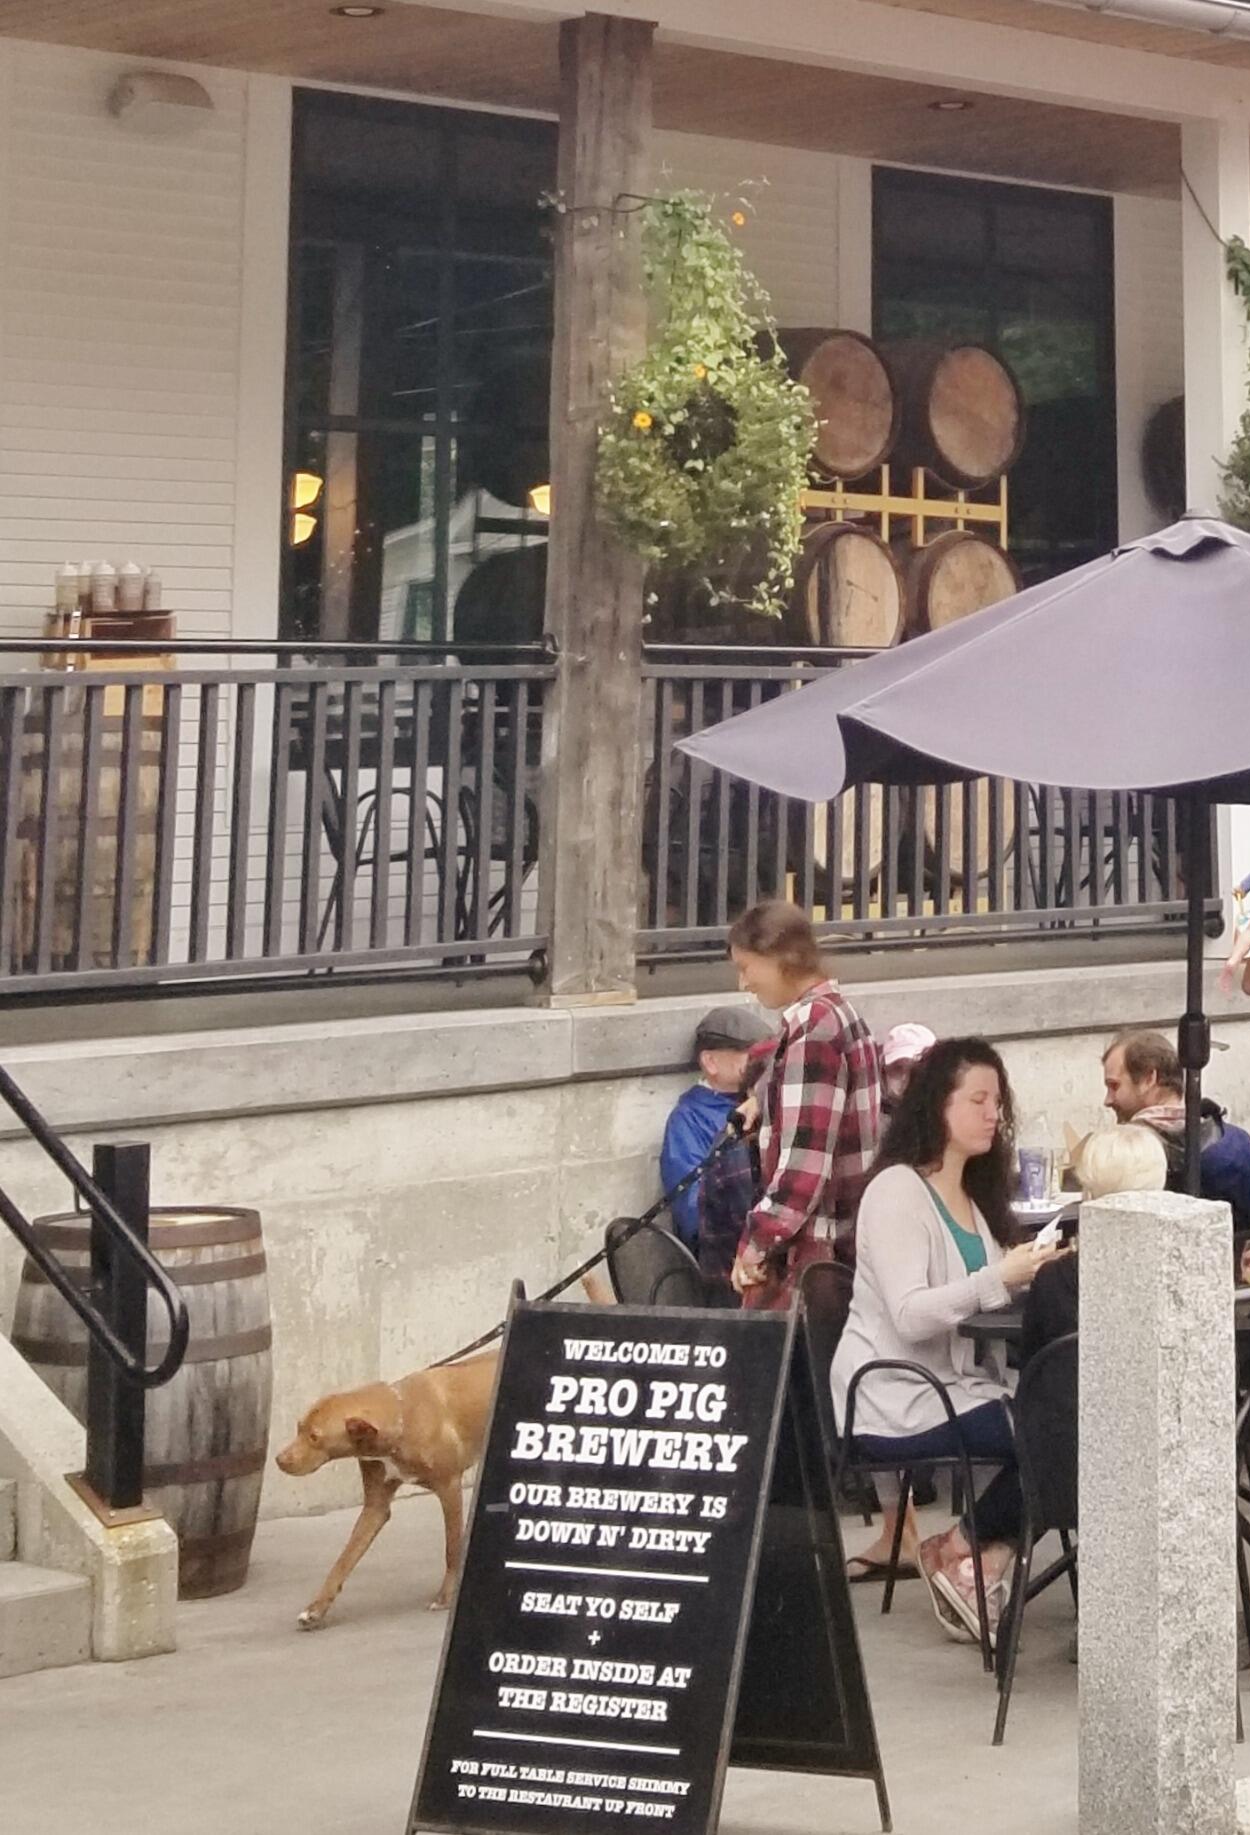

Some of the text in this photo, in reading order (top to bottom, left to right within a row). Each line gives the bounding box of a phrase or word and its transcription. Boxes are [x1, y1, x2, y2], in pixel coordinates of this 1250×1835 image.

[564, 1339, 727, 1368] WELCOME TO
[545, 1376, 727, 1422] PRO PIG
[511, 1422, 748, 1472] BREWERY
[510, 1483, 727, 1519] OUR BREWERY IS
[515, 1519, 712, 1553] DOWN N' DIRTY
[521, 1592, 680, 1623] SEAT YO SELF
[588, 1630, 601, 1645] +
[489, 1652, 692, 1688] ORDER INSIDE AT
[498, 1687, 667, 1721] THE REGISTER
[451, 1760, 690, 1795] FOR FULL TABLE SERVICE SHIMMY
[458, 1784, 675, 1818] TO THE RESTAURANT UP FRONT
